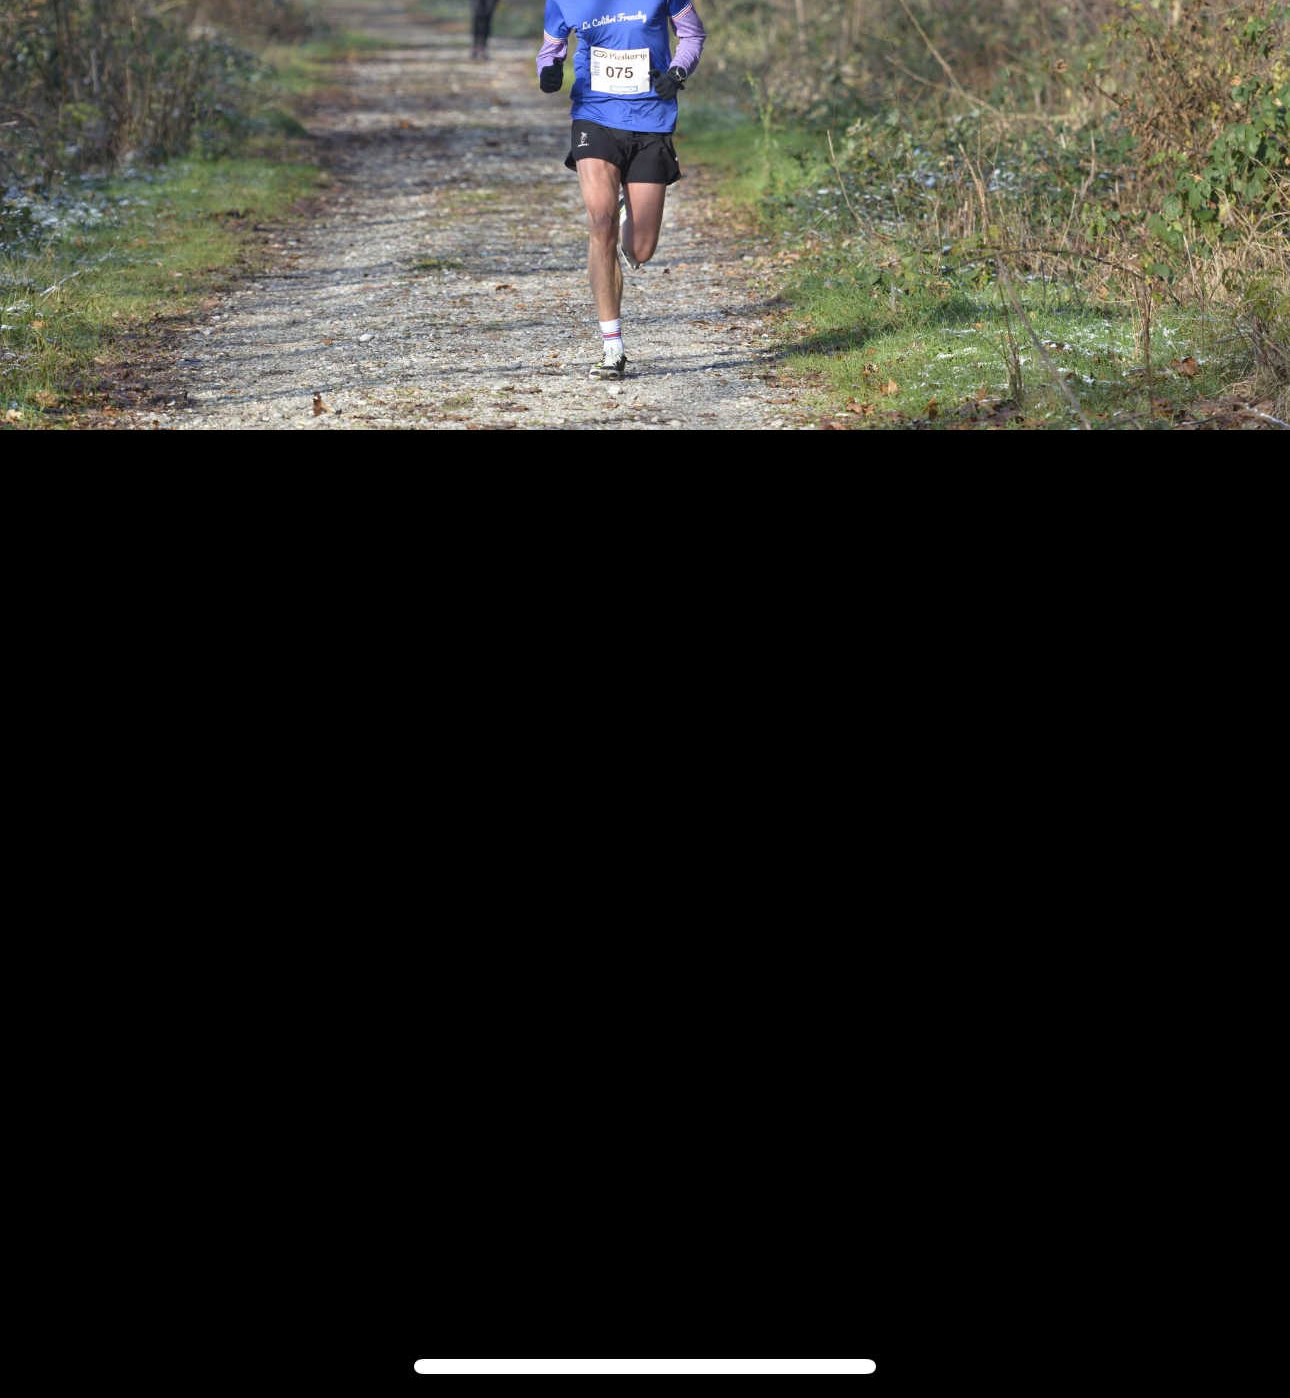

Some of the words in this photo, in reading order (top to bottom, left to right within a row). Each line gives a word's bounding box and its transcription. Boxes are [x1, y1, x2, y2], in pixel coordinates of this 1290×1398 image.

[582, 21, 591, 30] Le
[592, 14, 616, 27] Colibri
[617, 10, 647, 24] Frenchy
[605, 66, 634, 79] 075
